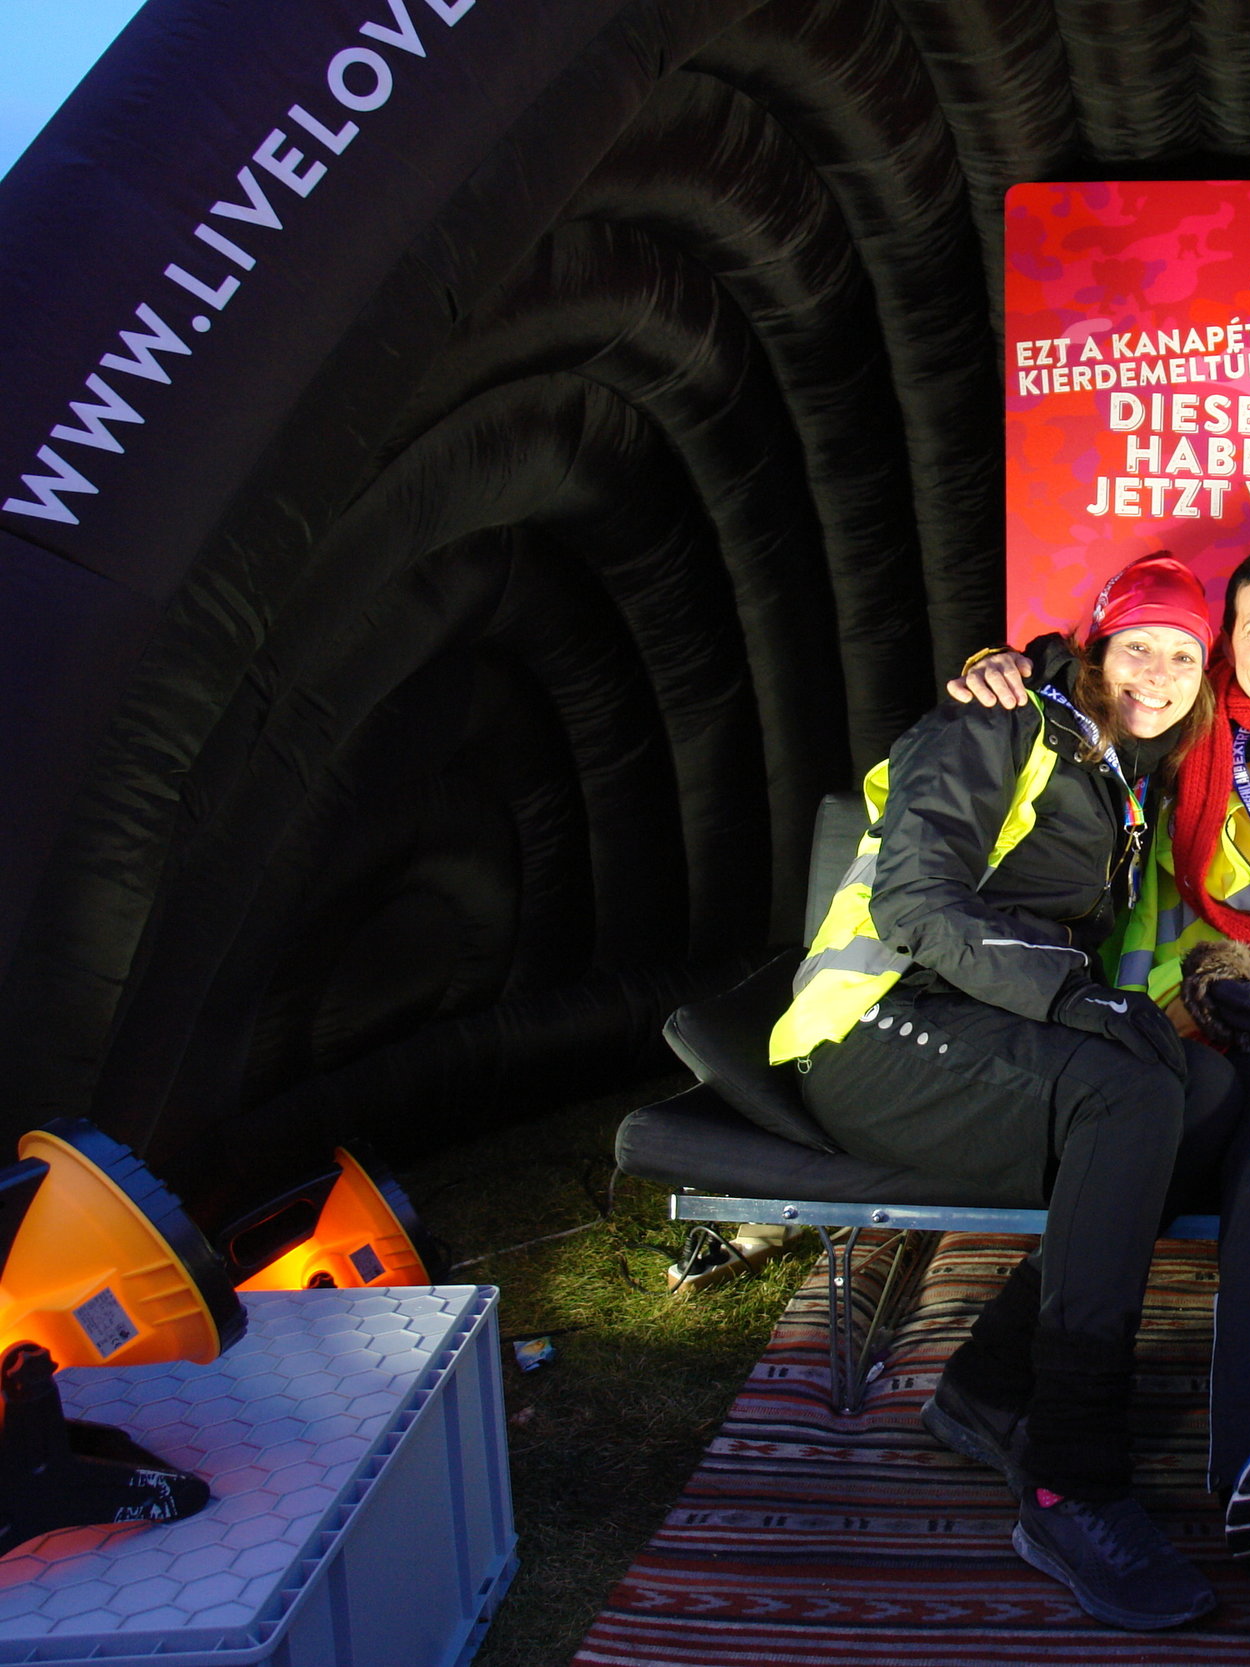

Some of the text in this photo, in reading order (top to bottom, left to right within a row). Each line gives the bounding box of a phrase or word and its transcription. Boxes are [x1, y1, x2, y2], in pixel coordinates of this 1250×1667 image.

[1016, 338, 1071, 367] EZT
[1080, 336, 1104, 362] A
[1086, 476, 1232, 520] JETZT
